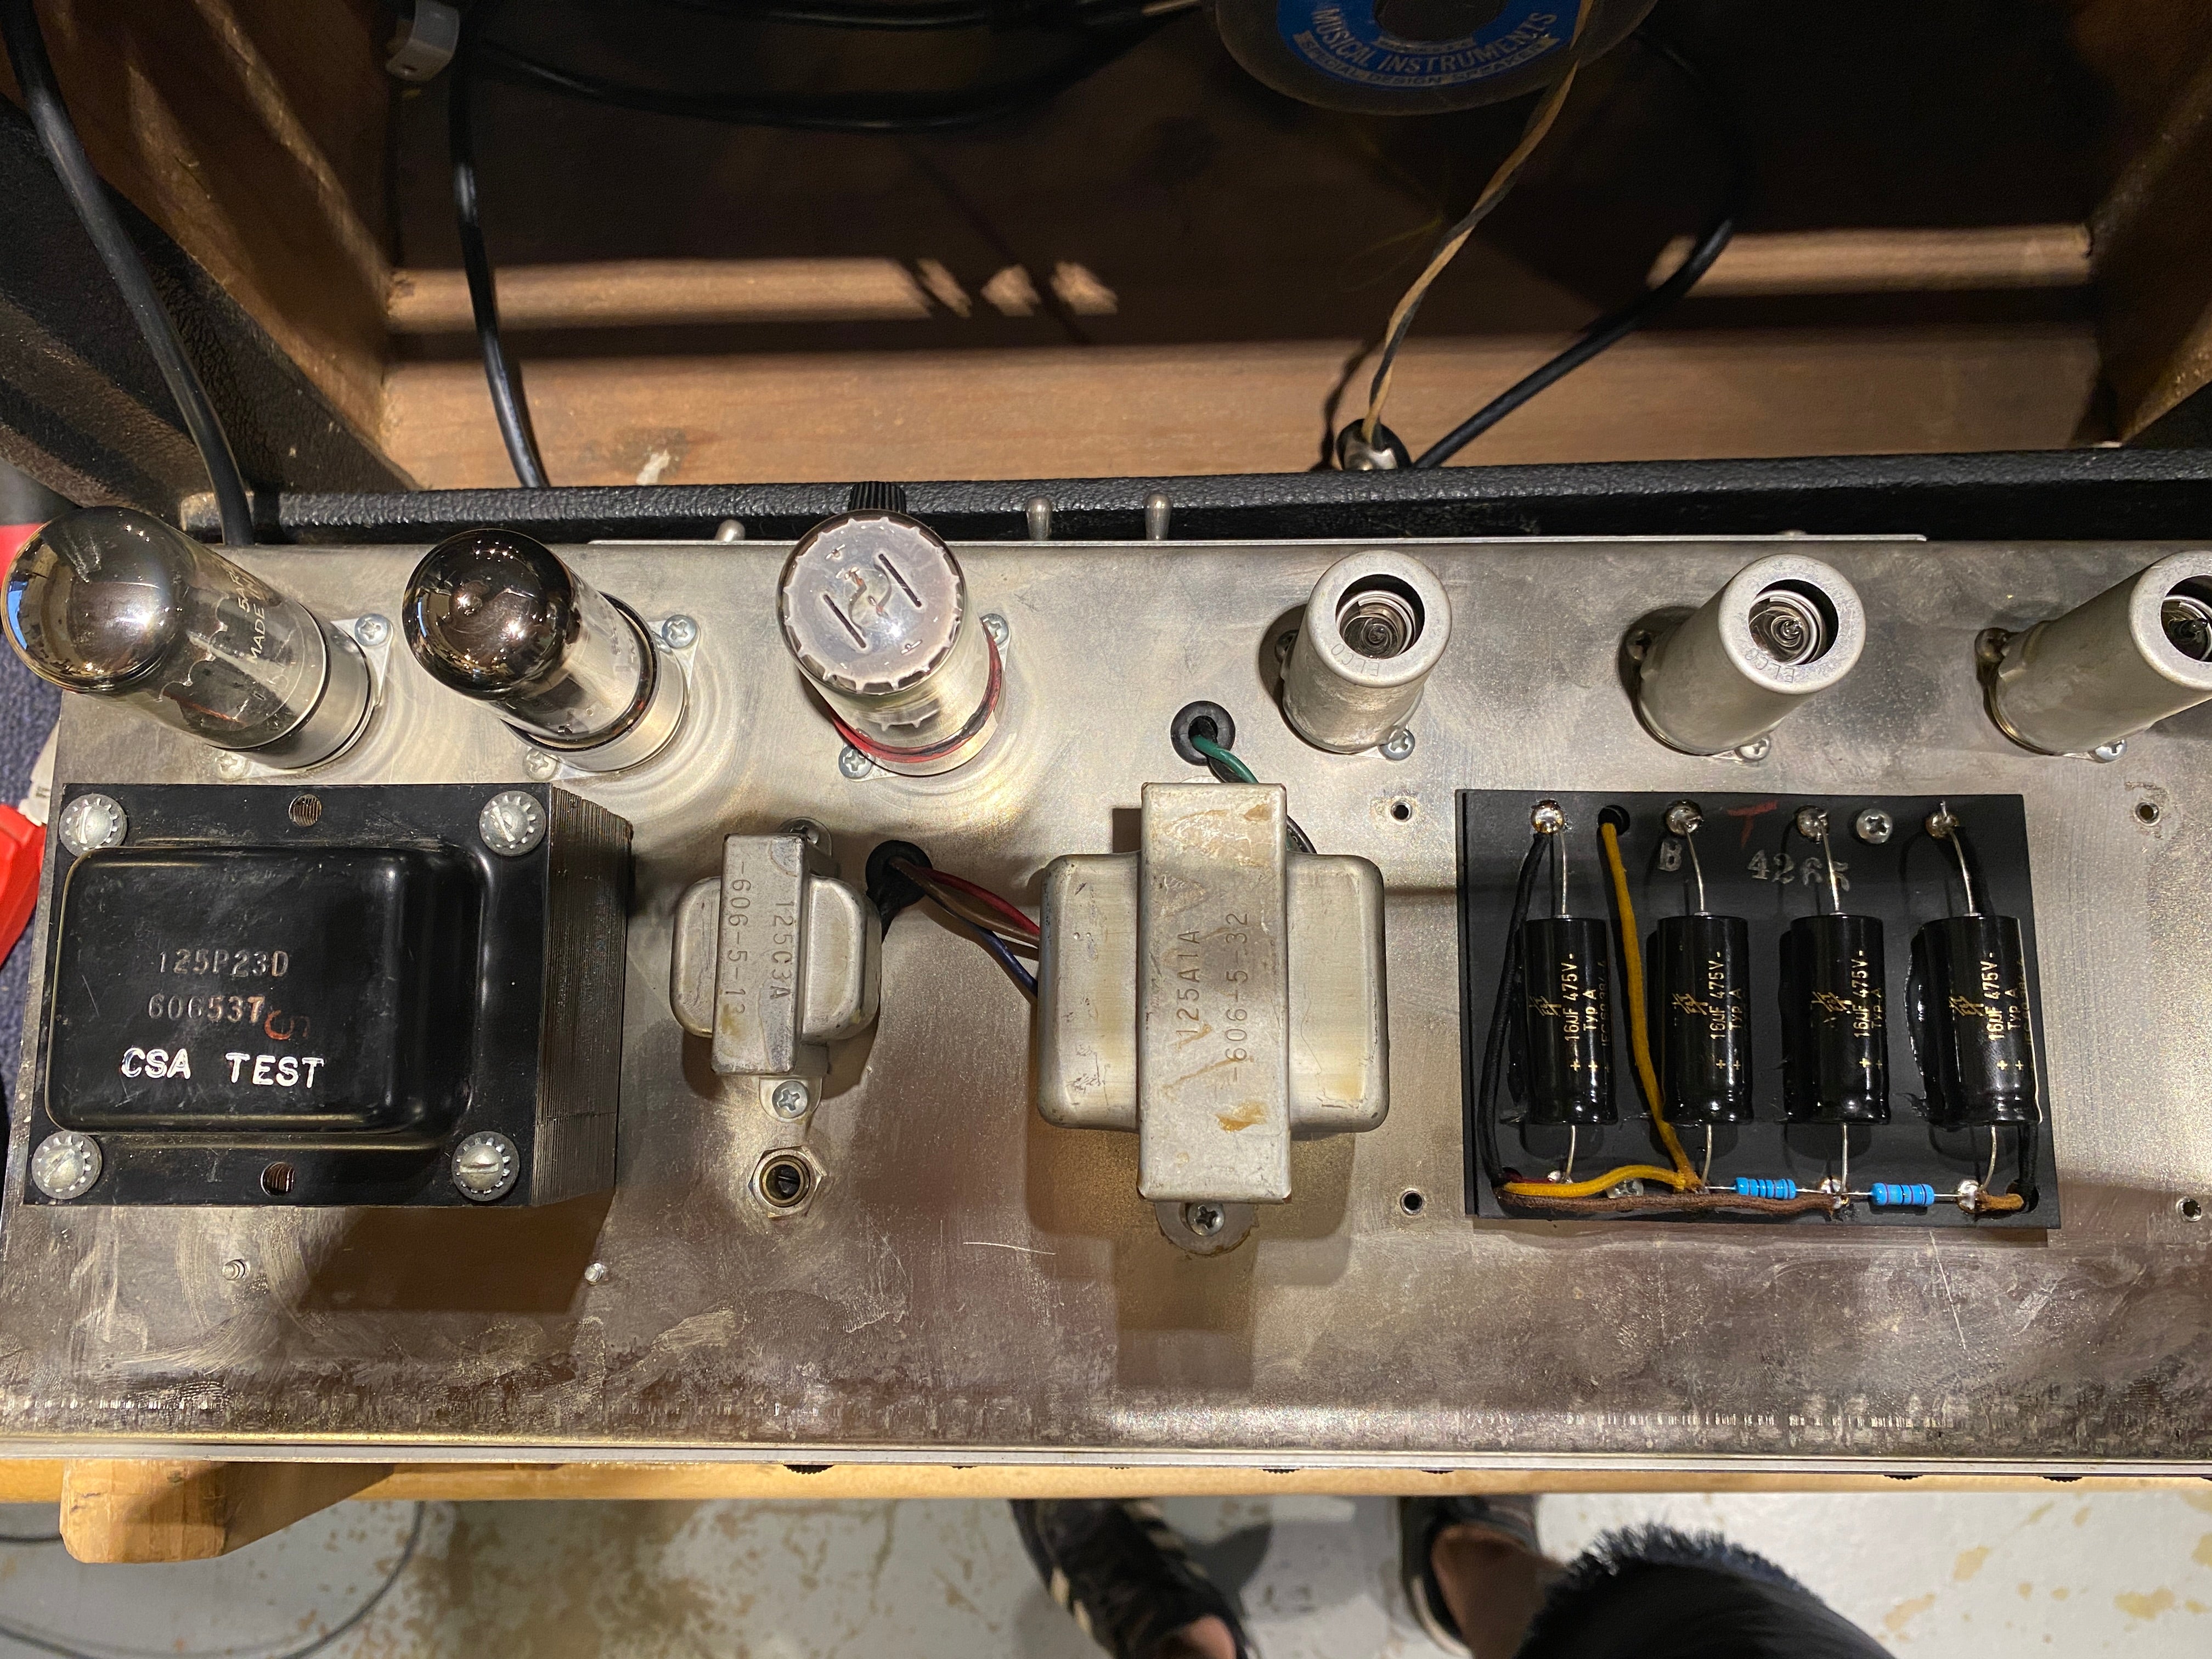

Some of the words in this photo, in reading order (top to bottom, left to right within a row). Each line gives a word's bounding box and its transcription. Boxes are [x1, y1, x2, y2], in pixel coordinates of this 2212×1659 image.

[1311, 8, 1376, 67] MUSICAL
[1378, 12, 1558, 74] INSTRUMENTS
[247, 603, 267, 665] MADE
[1331, 643, 1380, 677] ELCO
[1745, 648, 1796, 684] ELCO
[159, 949, 290, 978] 125P23D
[769, 900, 794, 1000] 125C3A
[1176, 930, 1200, 1036] 125A1A
[1224, 913, 1248, 1082] -606-5-32
[1583, 989, 1597, 1000] A
[1729, 988, 1741, 999] A
[2004, 988, 2018, 998] A
[120, 1047, 191, 1080] CSA
[225, 1052, 325, 1088] TEST
